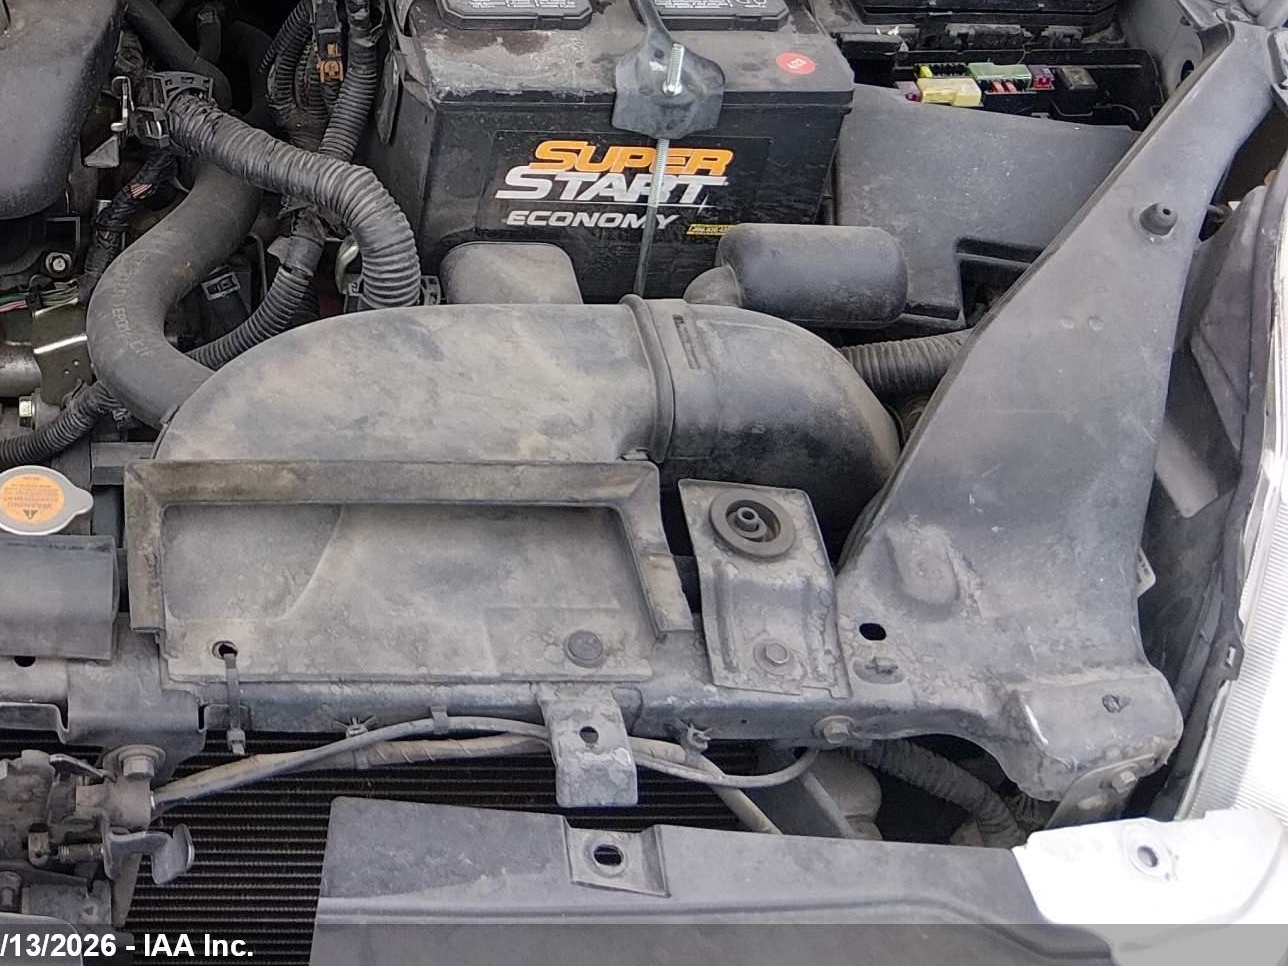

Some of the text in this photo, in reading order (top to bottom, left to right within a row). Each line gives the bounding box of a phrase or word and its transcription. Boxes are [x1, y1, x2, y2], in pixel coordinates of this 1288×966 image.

[527, 139, 734, 176] SUPER
[495, 165, 728, 205] START
[505, 210, 681, 229] ECONOMY
